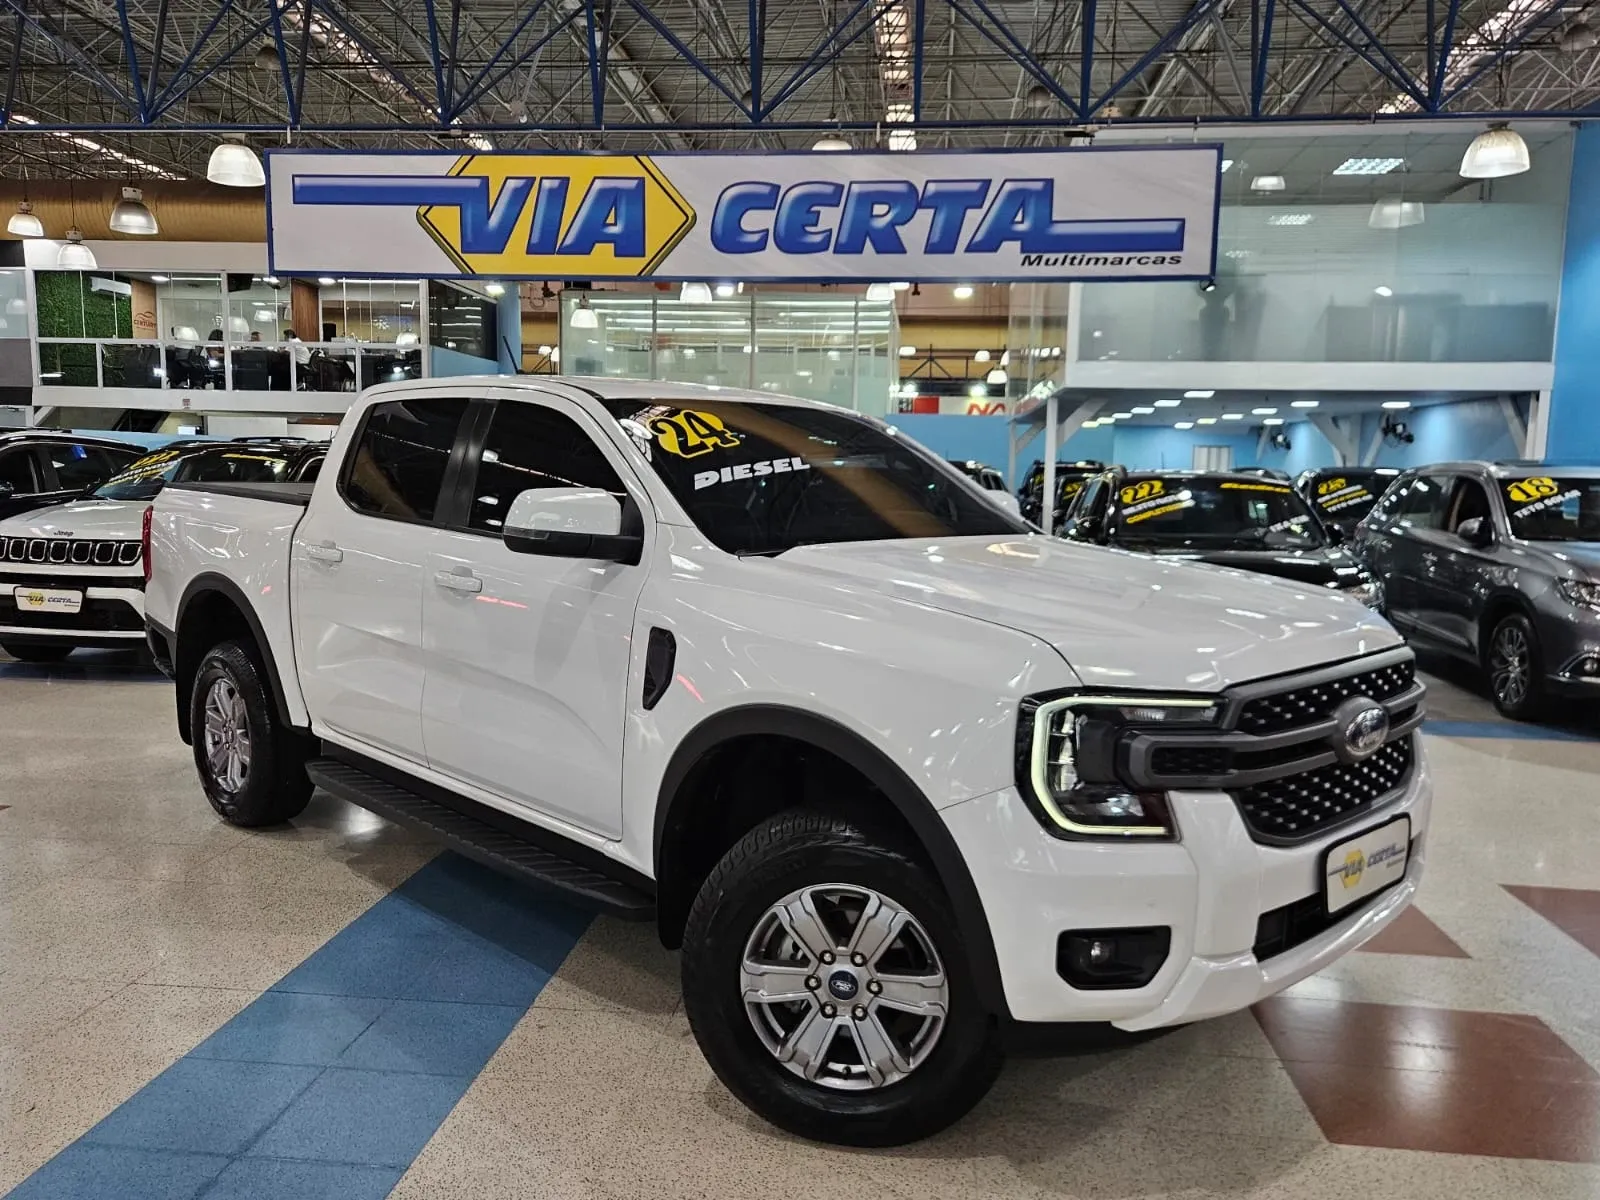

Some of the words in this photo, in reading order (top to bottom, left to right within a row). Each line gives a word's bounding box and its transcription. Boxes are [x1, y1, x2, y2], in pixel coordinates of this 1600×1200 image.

[455, 176, 646, 257] VIA
[710, 178, 1056, 255] CERTA
[1020, 253, 1182, 267] Multimarcas
[650, 411, 738, 457] 24
[694, 456, 811, 490] DIESEL
[1120, 480, 1164, 504] 22
[1508, 477, 1558, 501] 18
